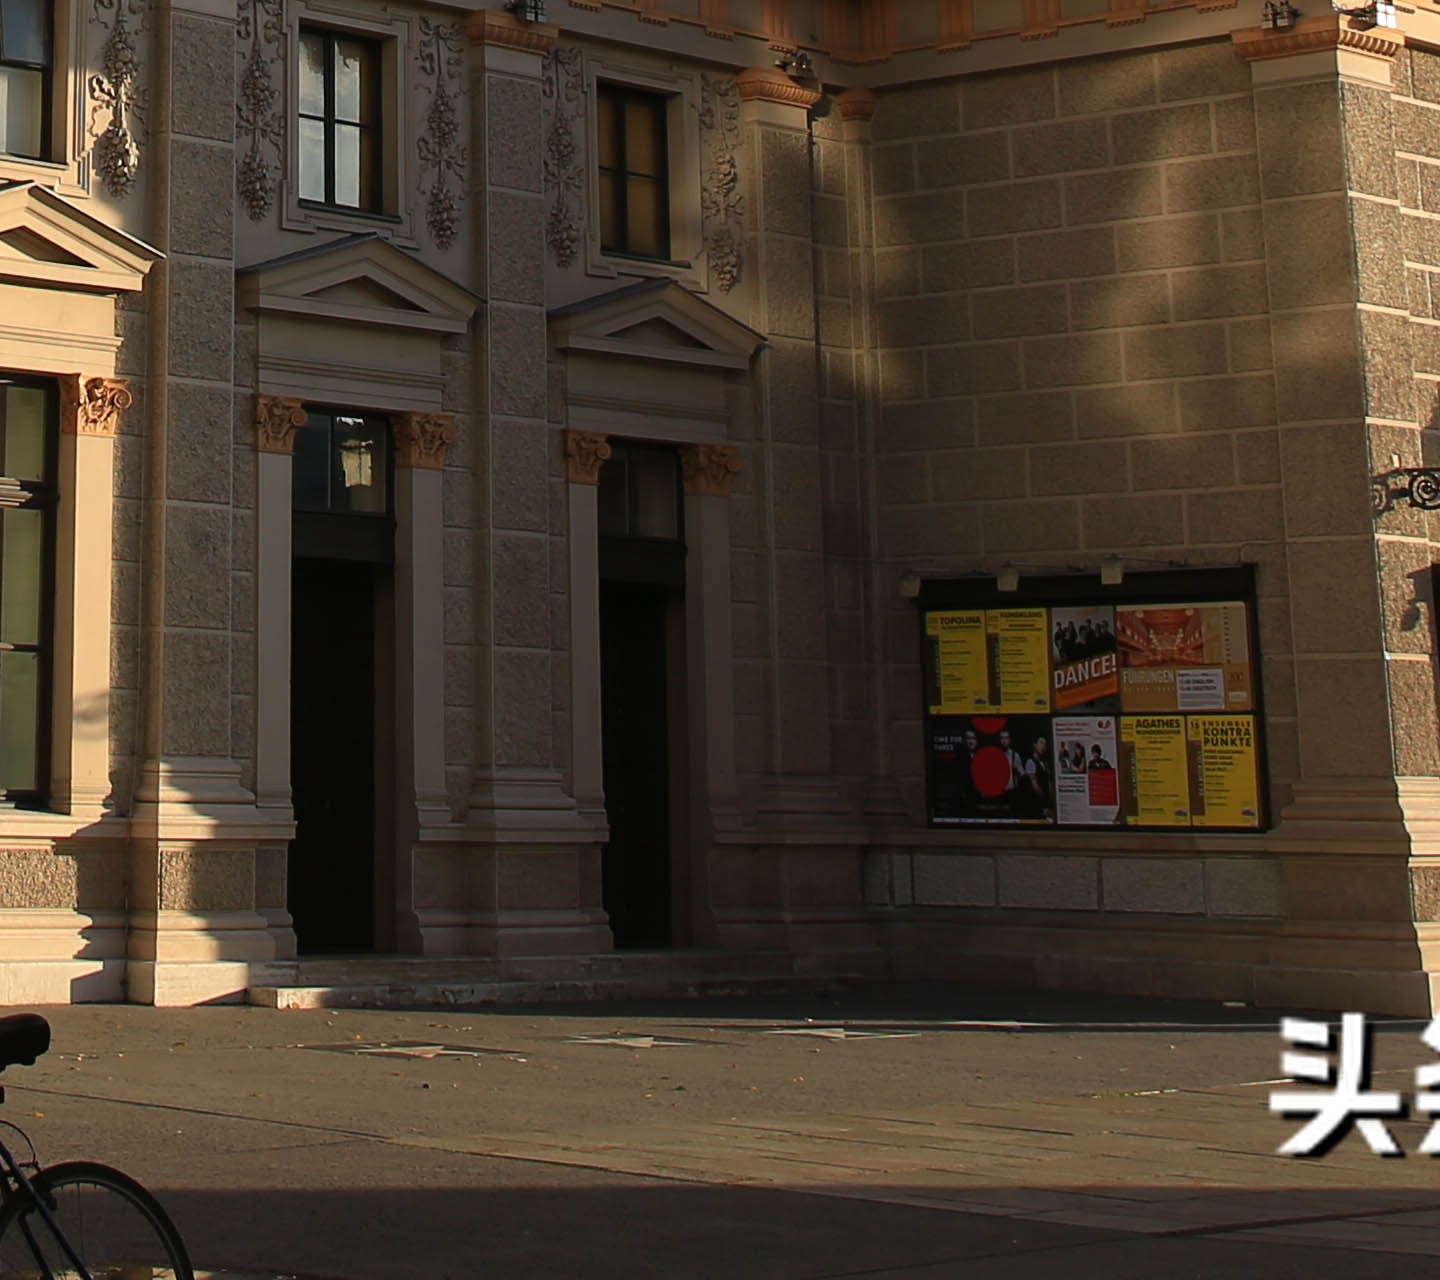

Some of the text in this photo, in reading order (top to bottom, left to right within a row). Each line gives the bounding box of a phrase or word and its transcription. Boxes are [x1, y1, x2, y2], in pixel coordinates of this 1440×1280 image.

[1054, 653, 1117, 689] DANCE!
[1135, 719, 1181, 729] AGATHES
[1203, 727, 1251, 737] KONTRA
[1203, 737, 1252, 747] PUNKTE
